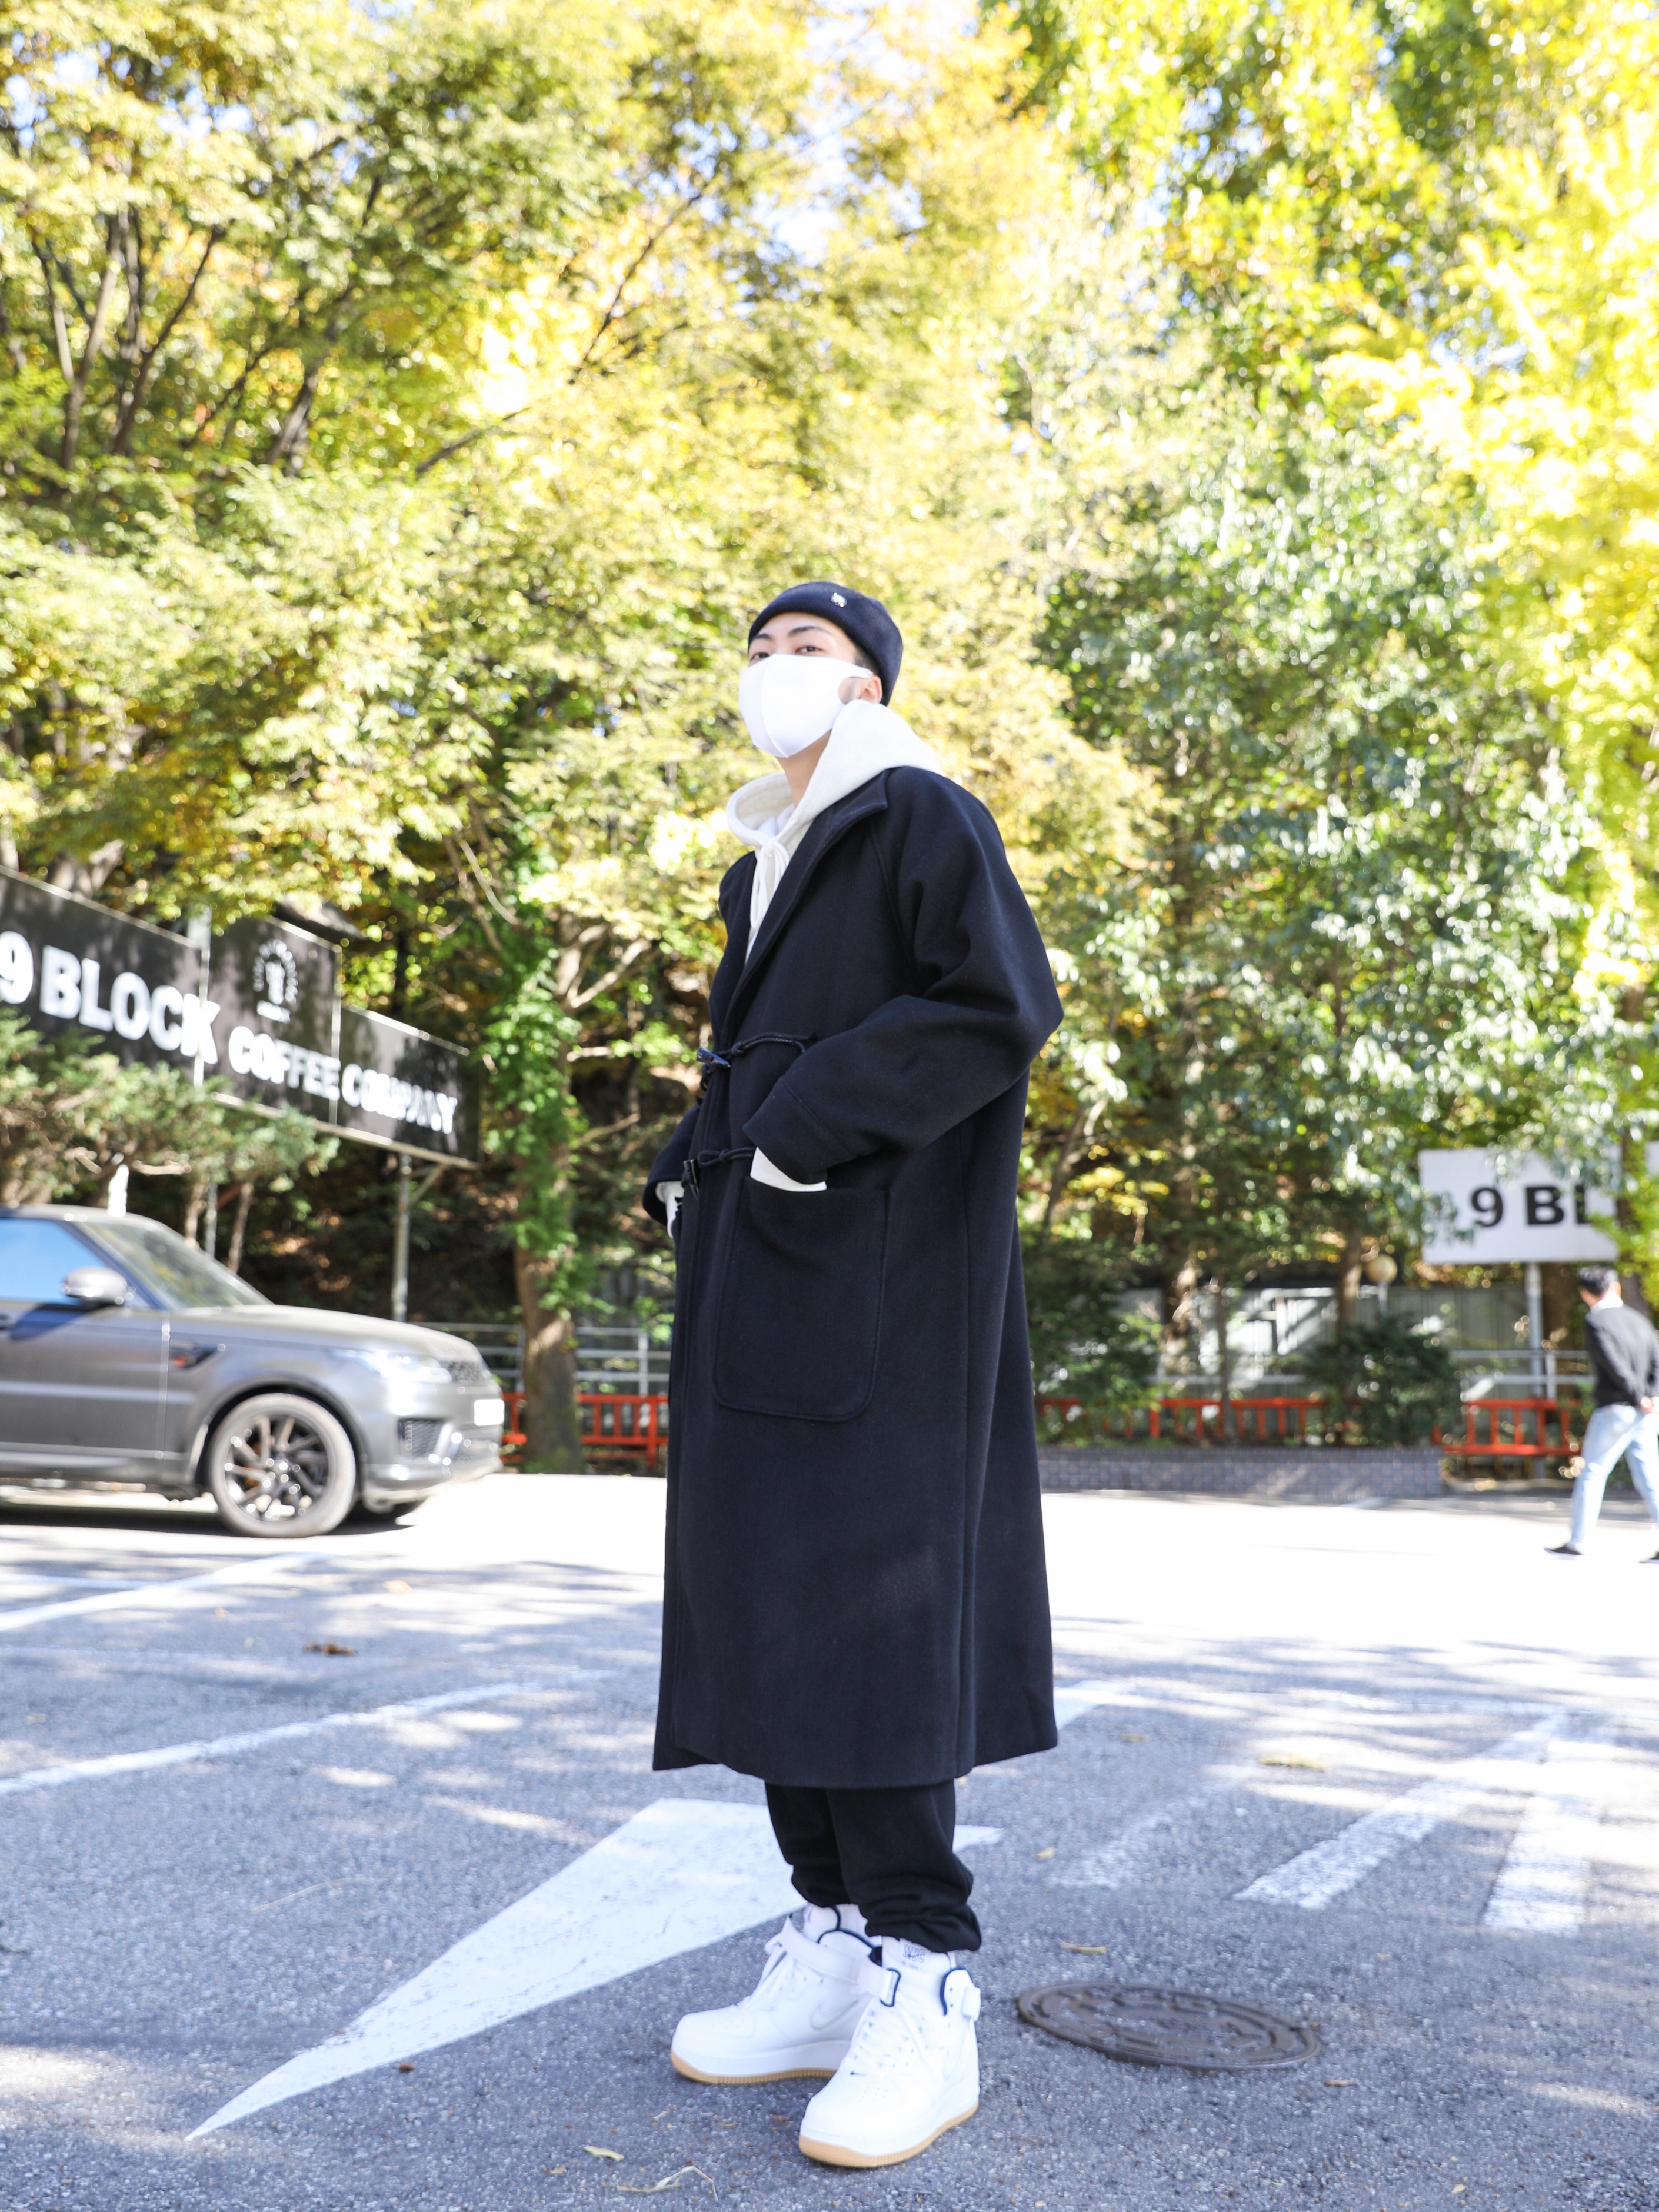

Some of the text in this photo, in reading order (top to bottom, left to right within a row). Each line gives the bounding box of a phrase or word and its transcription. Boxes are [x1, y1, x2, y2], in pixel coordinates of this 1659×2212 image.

[0, 931, 221, 1064] 9 BLOCK
[228, 1025, 458, 1135] COFFEE COMPANY
[1471, 1187, 1504, 1227] 9
